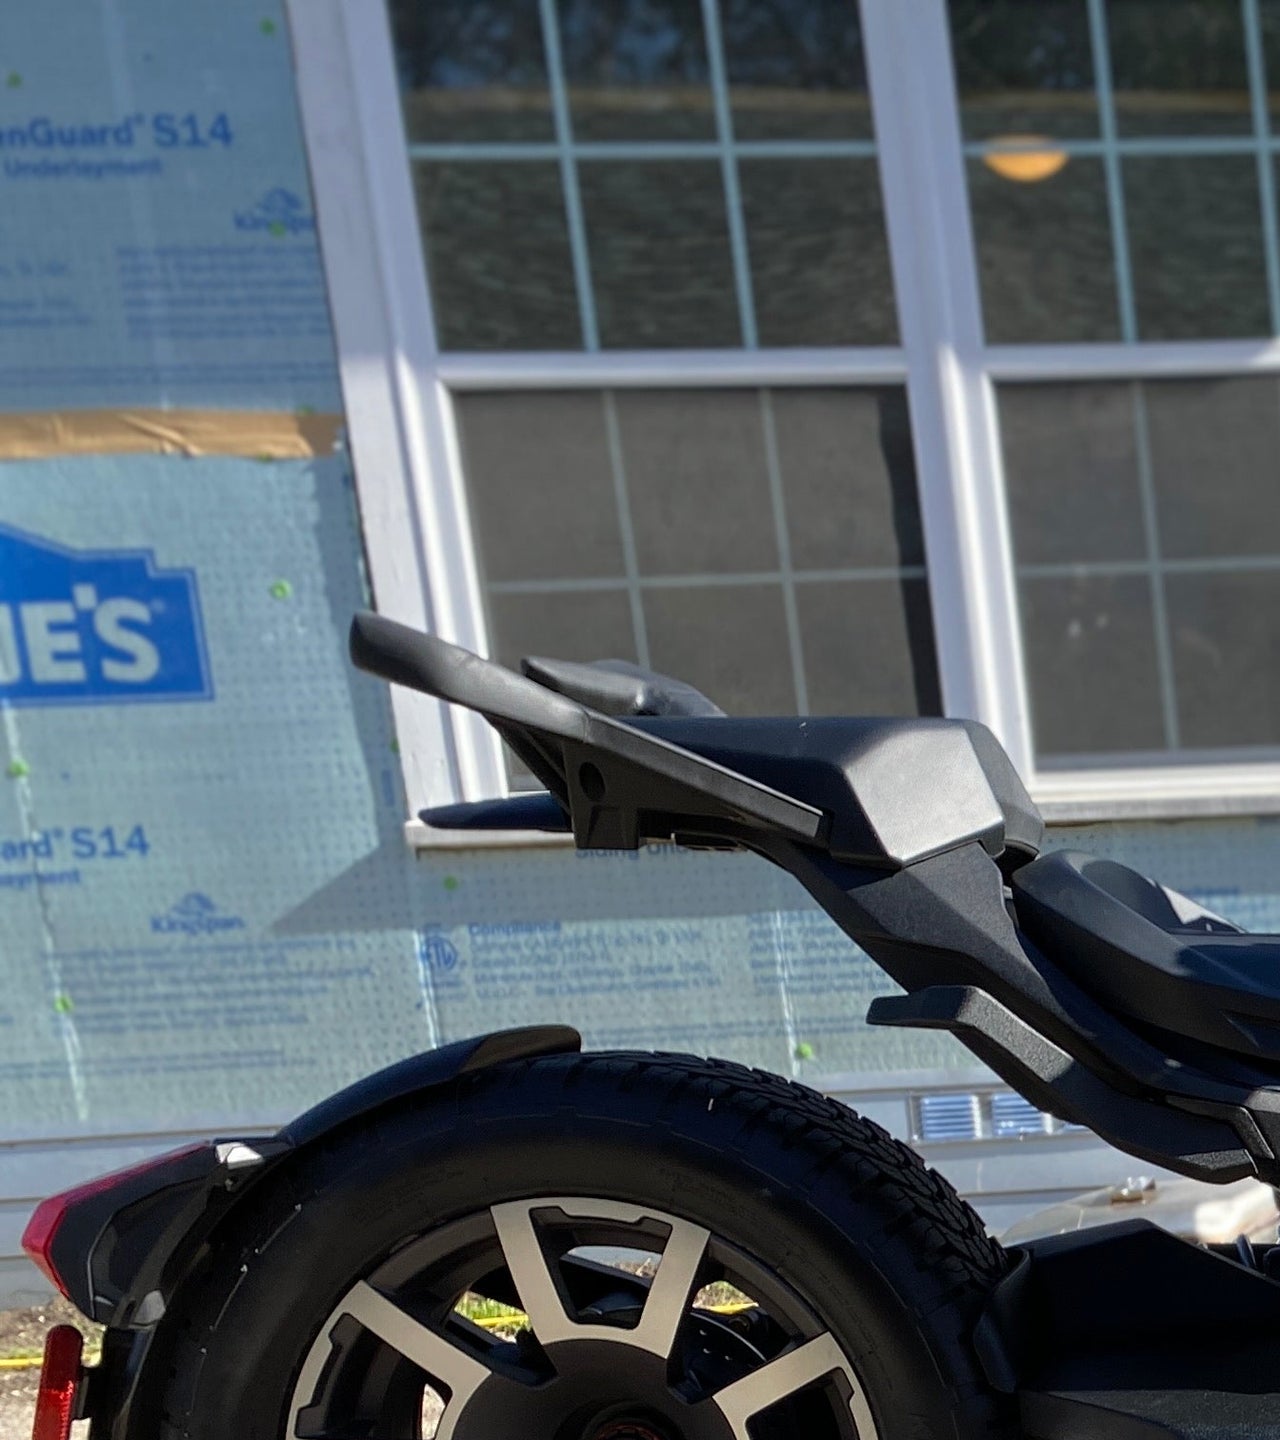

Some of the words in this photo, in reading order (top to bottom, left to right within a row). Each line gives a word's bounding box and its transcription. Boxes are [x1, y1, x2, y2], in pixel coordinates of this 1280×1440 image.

[152, 112, 234, 149] S14
[0, 584, 161, 684] E'S
[71, 824, 151, 859] S14
